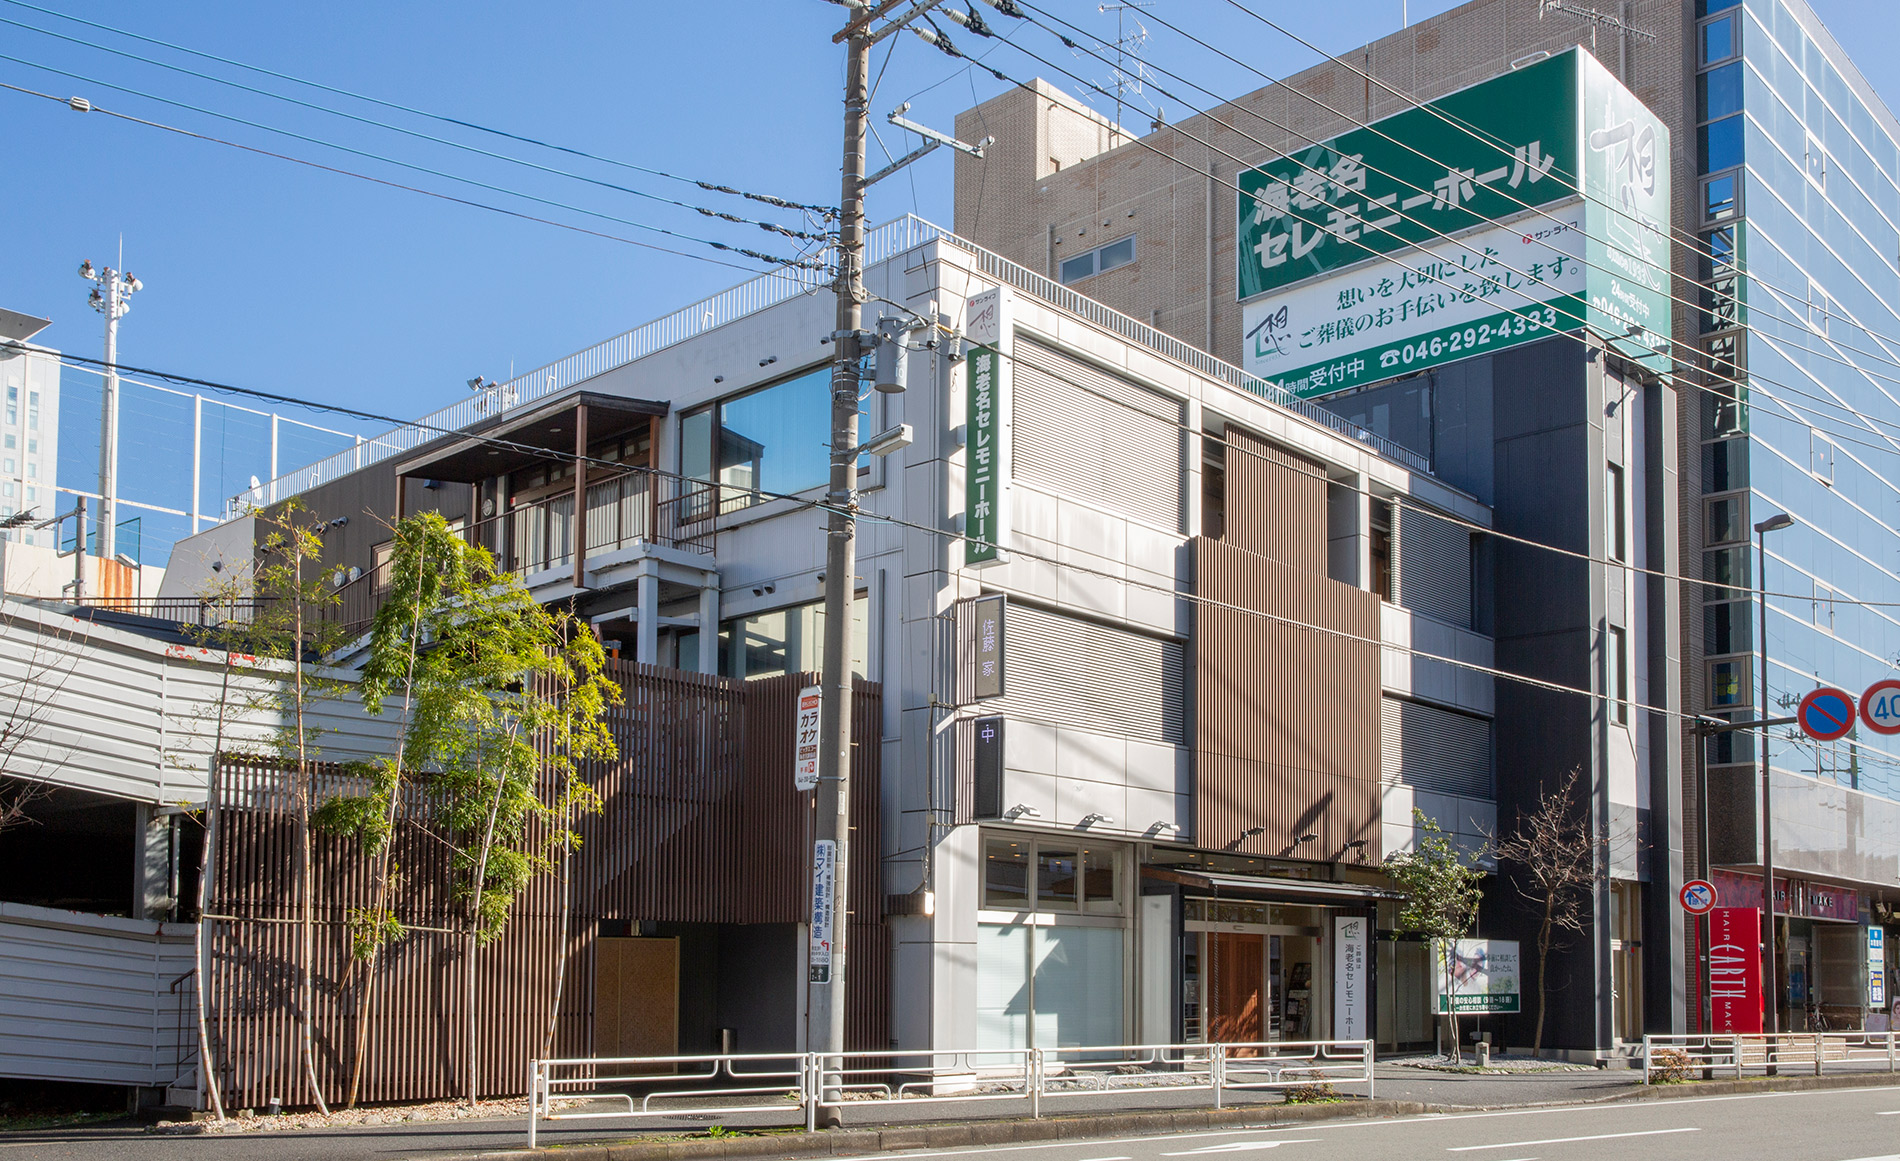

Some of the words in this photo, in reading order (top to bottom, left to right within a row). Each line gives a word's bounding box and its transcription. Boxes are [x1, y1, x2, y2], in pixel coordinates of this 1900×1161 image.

[1253, 153, 1366, 226] 海老名
[1253, 140, 1555, 269] セレモニーホール
[1299, 256, 1578, 348] ご葬儀のお手伝いを致します。
[1337, 247, 1499, 311] 想いを大切にした
[1402, 308, 1557, 364] 046-292-4333
[974, 353, 991, 554] 海老名セレモニーホール
[1723, 910, 1731, 941] HAIR
[1811, 895, 1833, 907] MAKE
